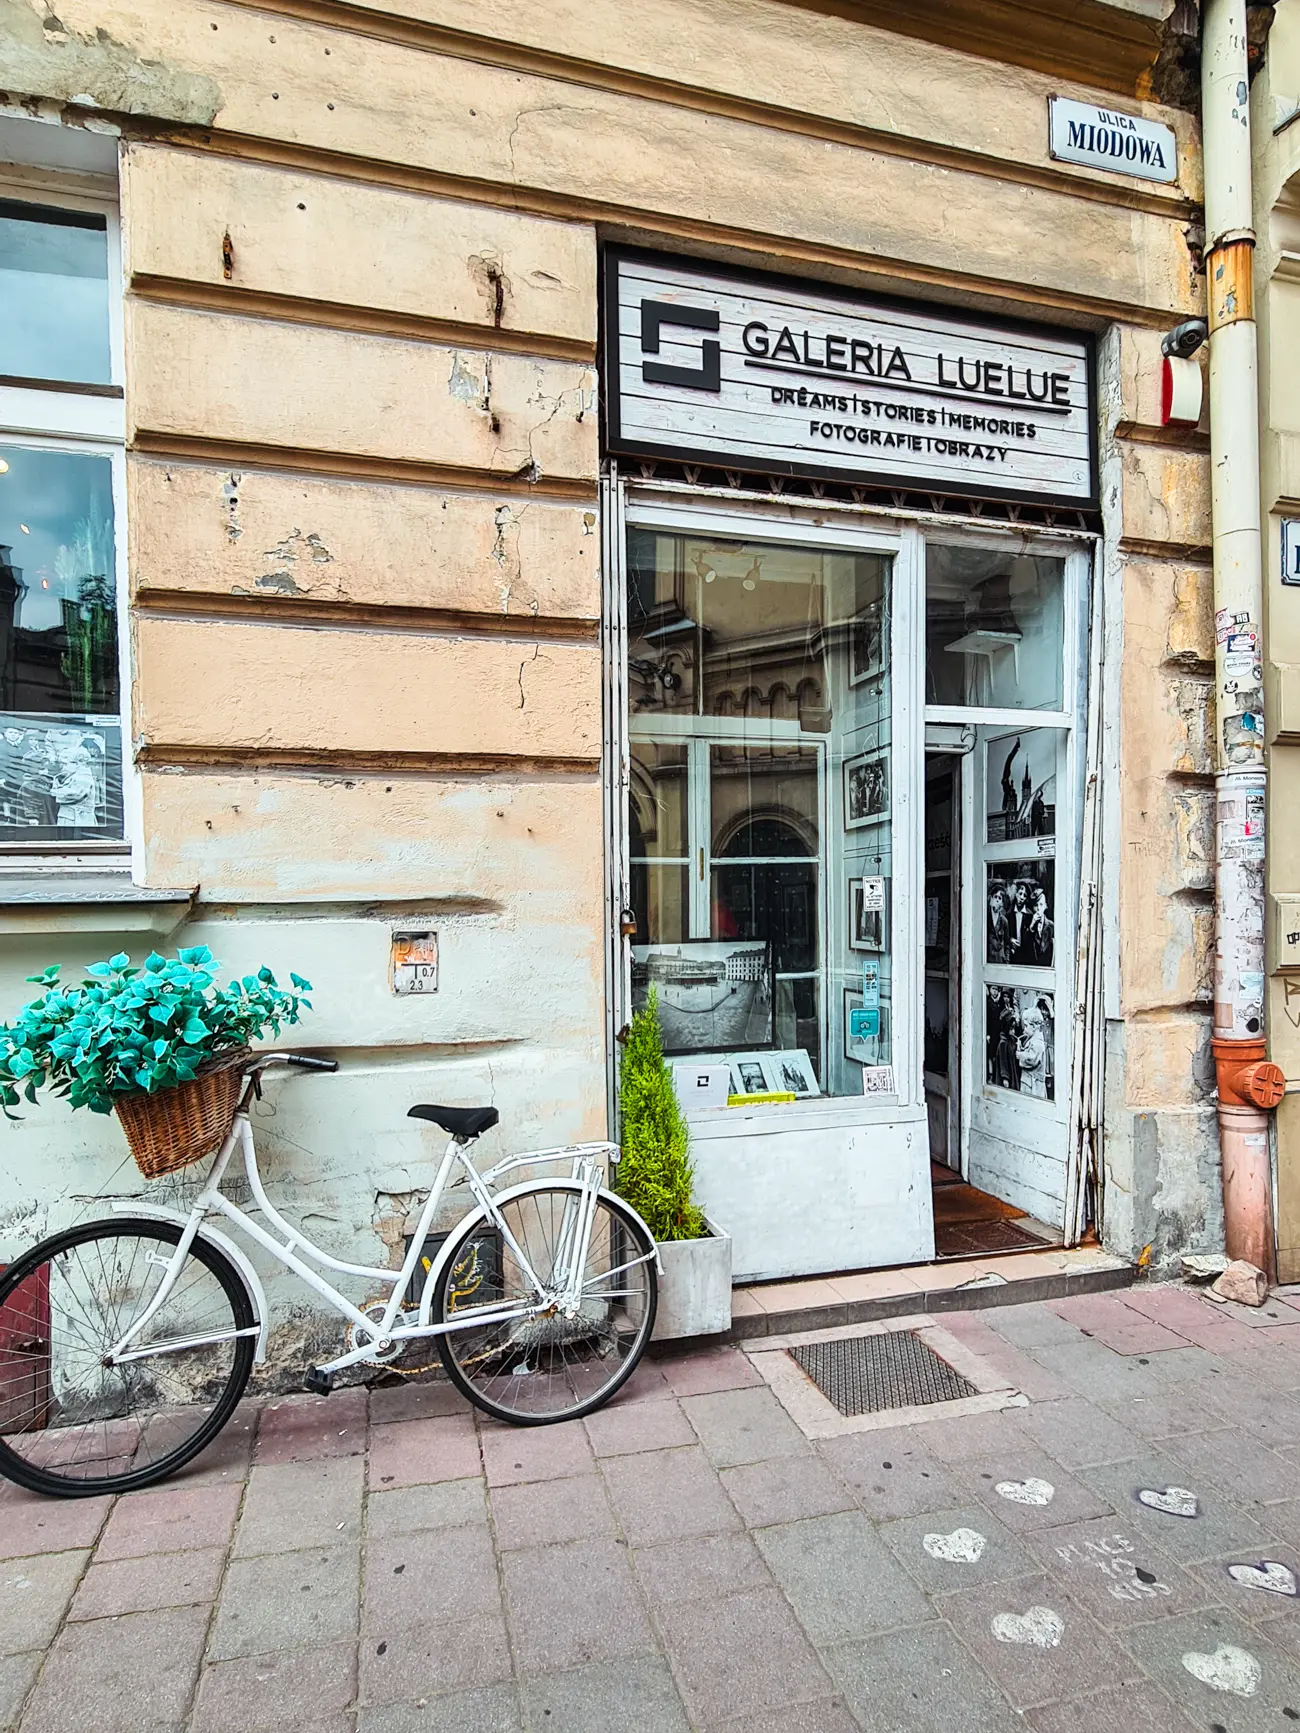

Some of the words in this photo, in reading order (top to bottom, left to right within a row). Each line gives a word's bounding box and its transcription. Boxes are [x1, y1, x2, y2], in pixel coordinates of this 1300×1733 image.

[1097, 110, 1137, 132] ULICA
[1067, 120, 1167, 169] MIODOWA
[742, 320, 913, 381] GALERIA
[937, 352, 1071, 406] LUELUE
[861, 399, 937, 425] STORIES
[949, 411, 1037, 438] MEMORIES
[810, 420, 923, 451] FOTOGRAFIE
[934, 438, 1009, 462] OBRAZY
[409, 980, 424, 991] 2.3
[422, 966, 435, 978] 0.7
